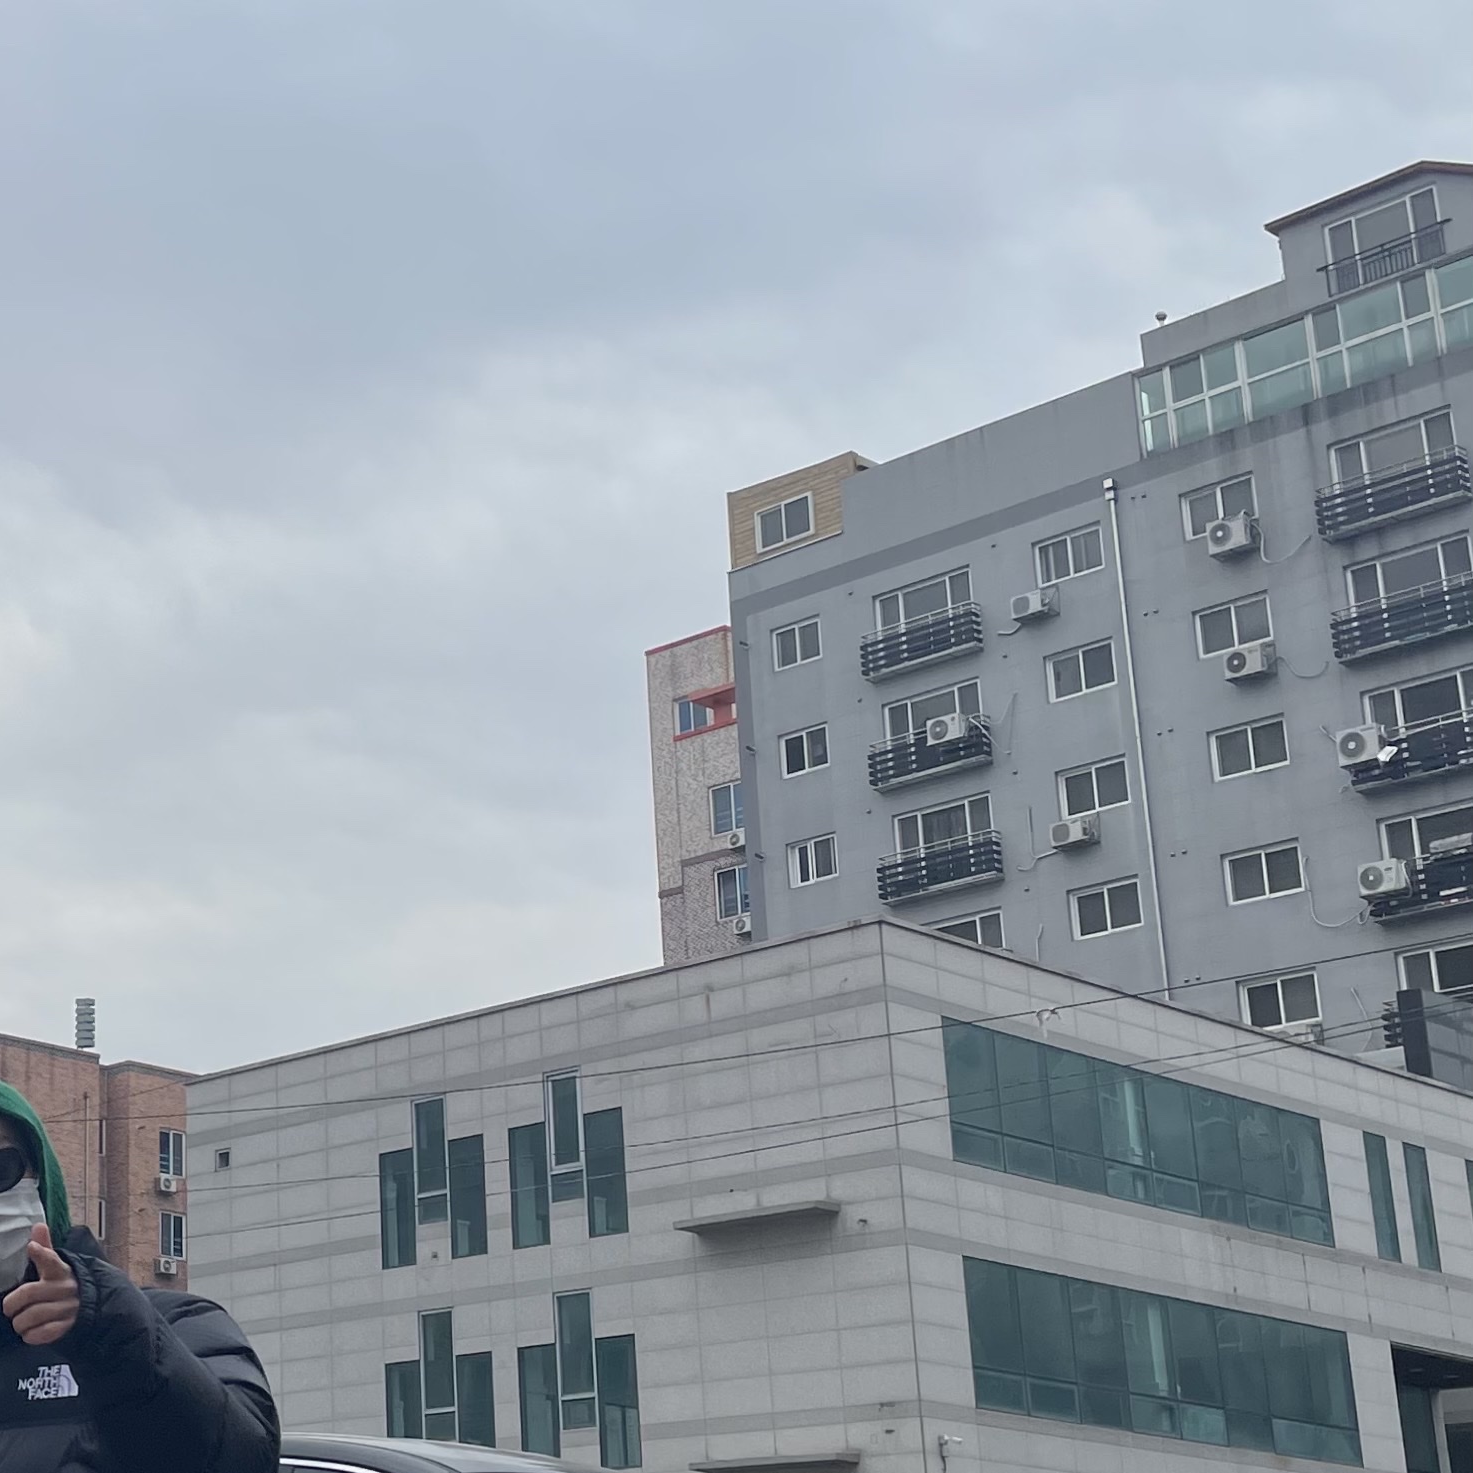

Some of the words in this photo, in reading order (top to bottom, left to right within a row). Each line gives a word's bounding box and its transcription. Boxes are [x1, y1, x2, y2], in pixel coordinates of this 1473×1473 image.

[38, 1365, 60, 1378] THE
[17, 1376, 59, 1390] NORTH
[27, 1387, 58, 1400] FACE
